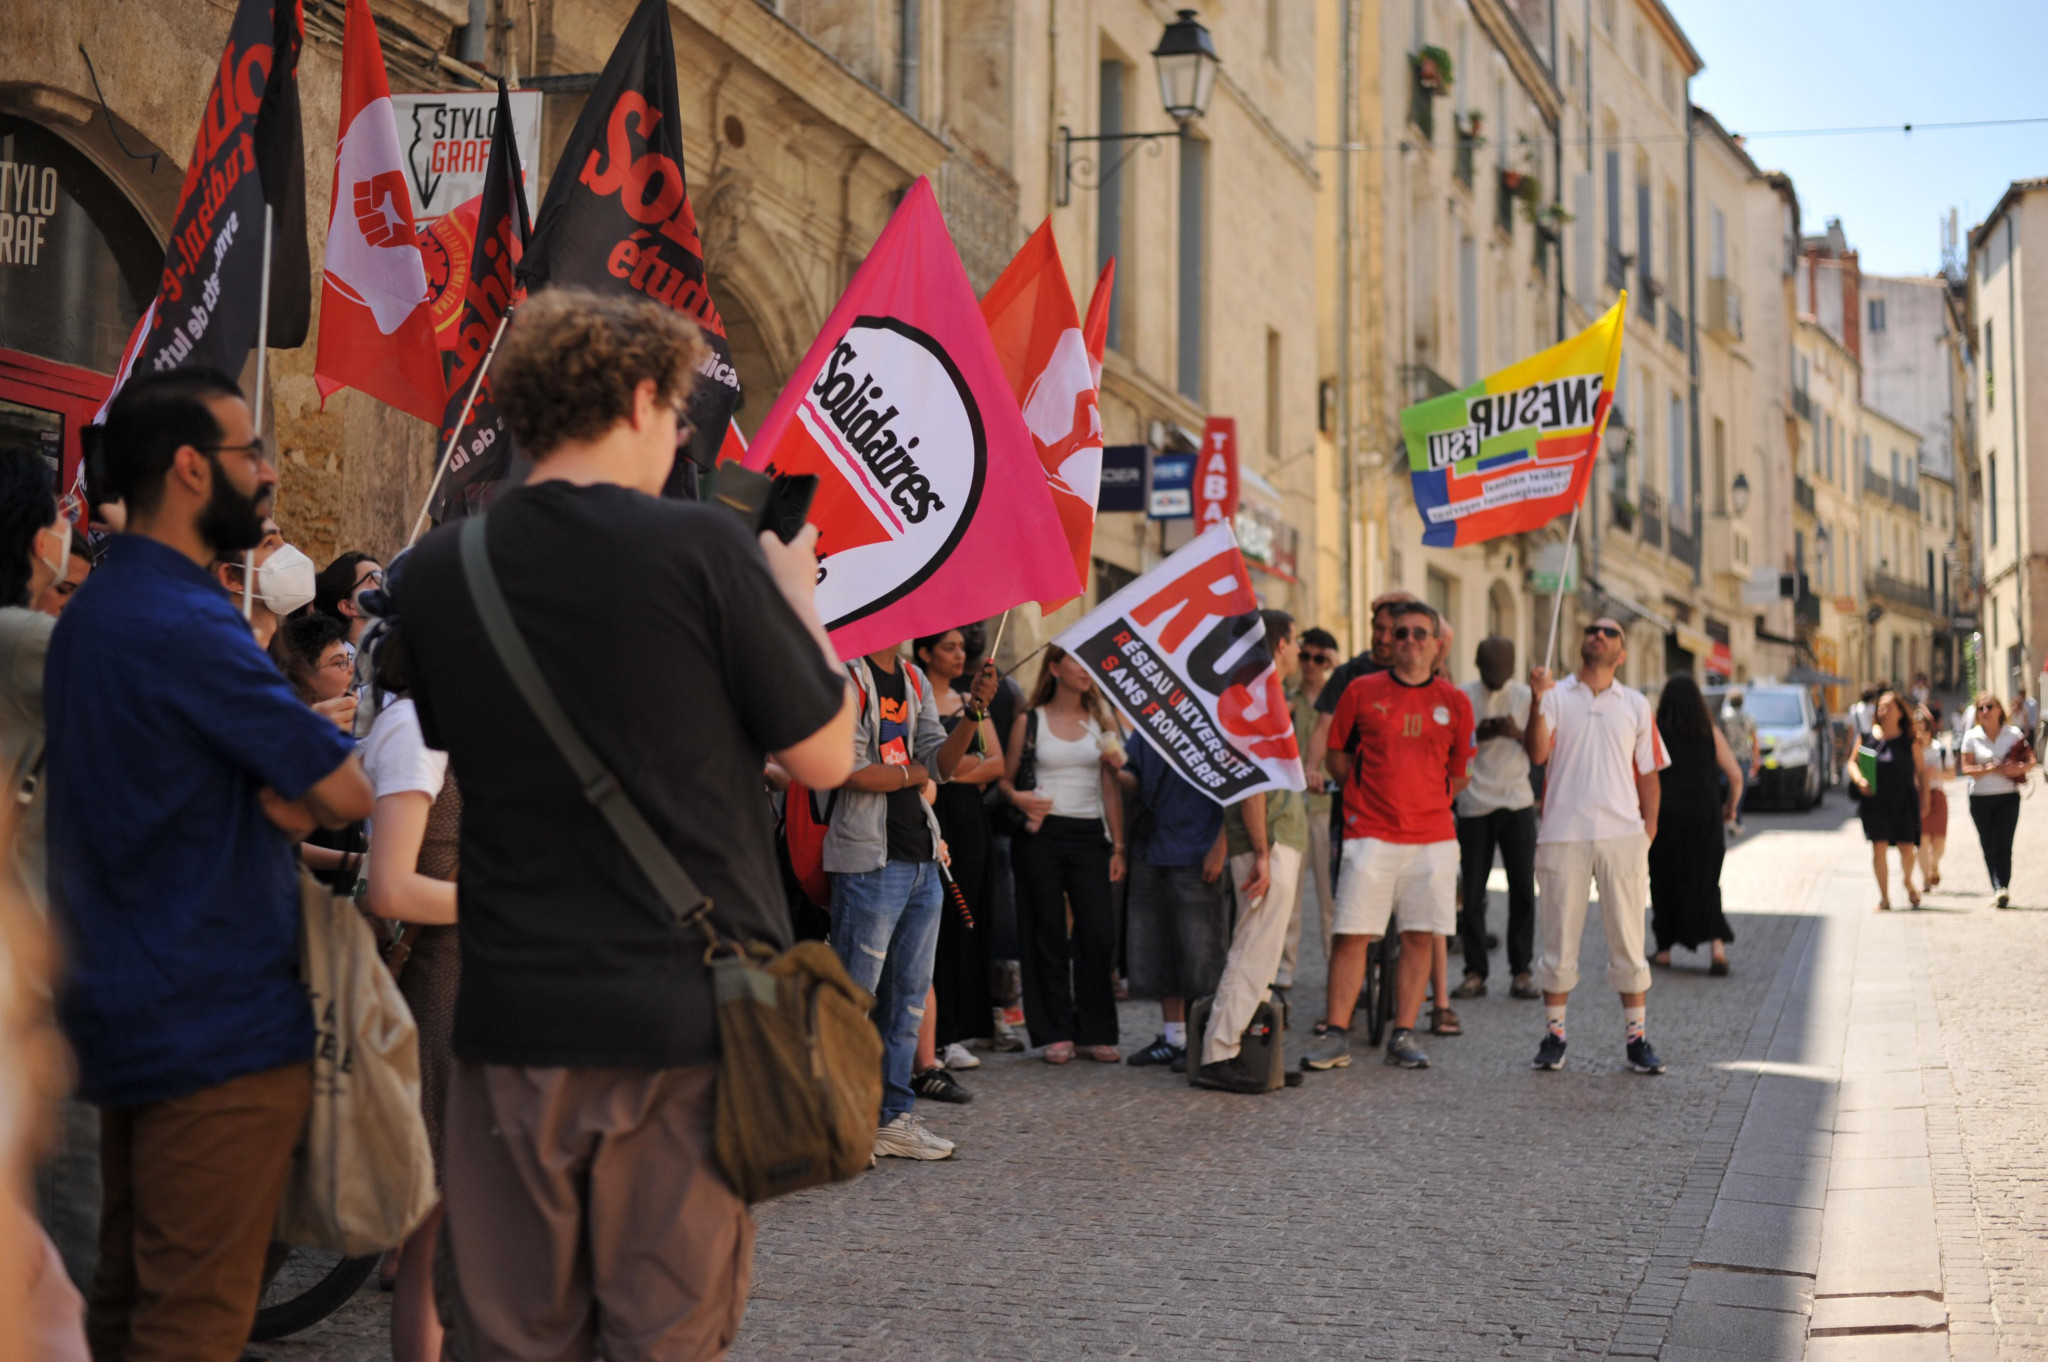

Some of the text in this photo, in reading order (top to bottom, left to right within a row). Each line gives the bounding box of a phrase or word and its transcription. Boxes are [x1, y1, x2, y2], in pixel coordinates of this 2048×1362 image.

[431, 140, 491, 174] GRAF
[812, 341, 946, 524] Solidaires
[1101, 655, 1228, 788] SANS FRONTIÈRES
[1113, 630, 1256, 780] RÉSEAU UNIVERSITÉ
[1402, 713, 1422, 737] 10
